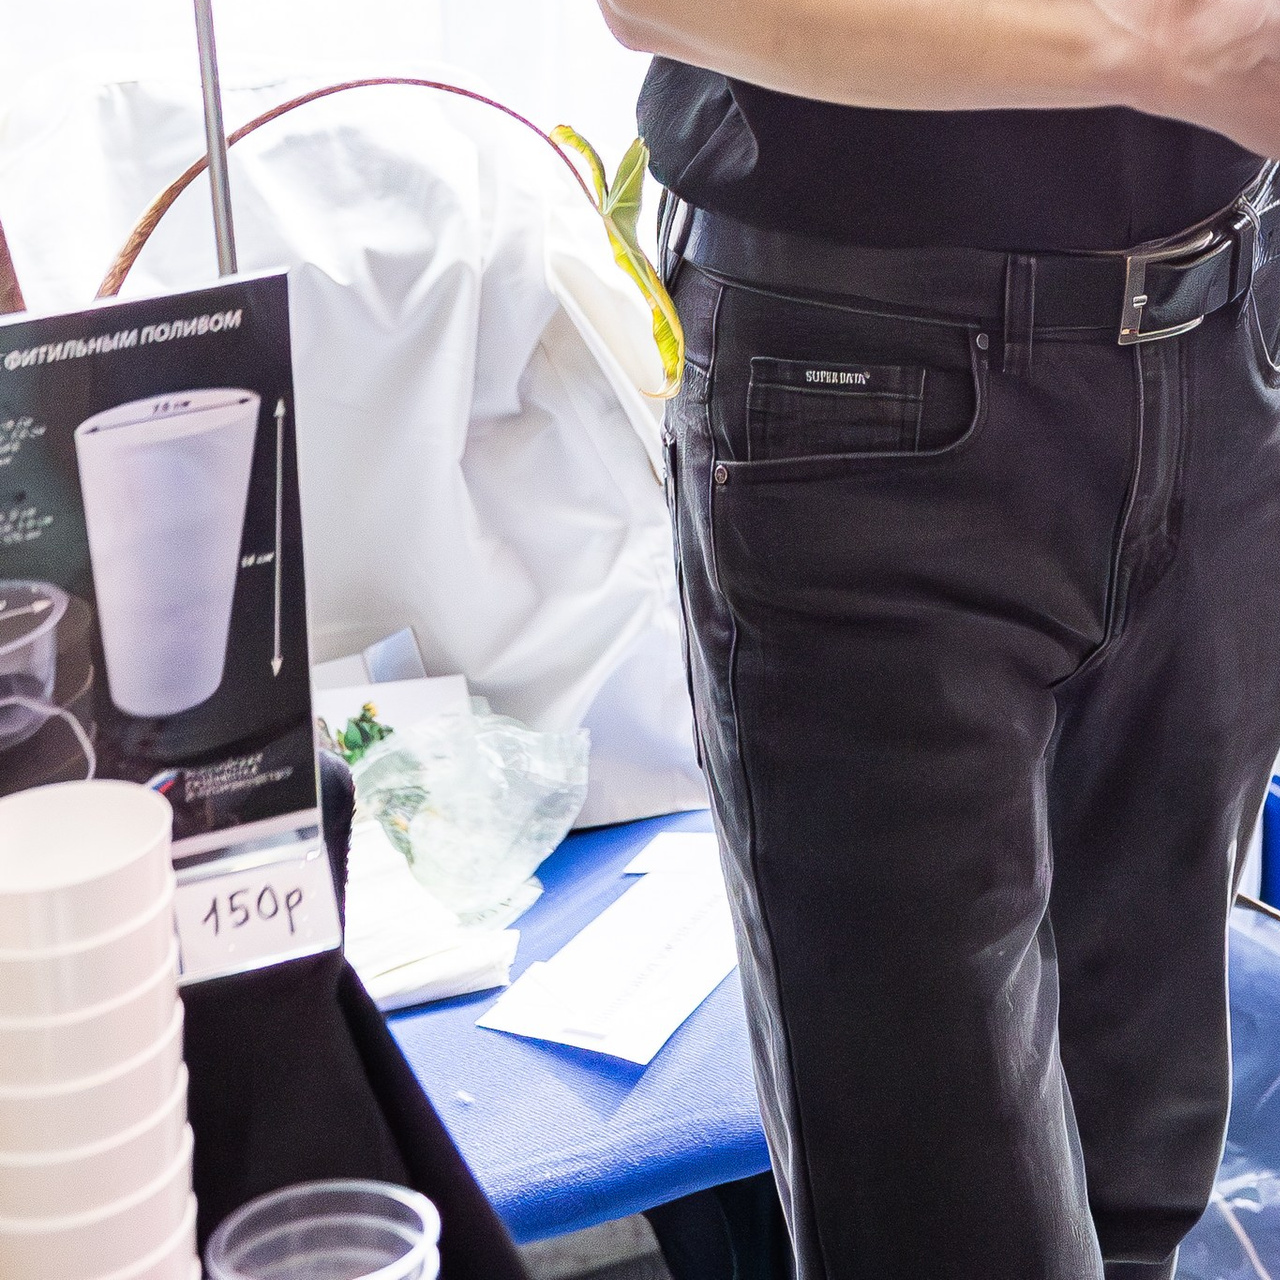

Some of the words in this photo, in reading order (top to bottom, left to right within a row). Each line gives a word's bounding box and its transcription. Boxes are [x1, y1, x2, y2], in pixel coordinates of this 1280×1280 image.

[4, 328, 139, 371] ФИТИЛЬНЫМ
[140, 308, 243, 345] ПОЛИВОМ
[203, 885, 303, 935] 150р
